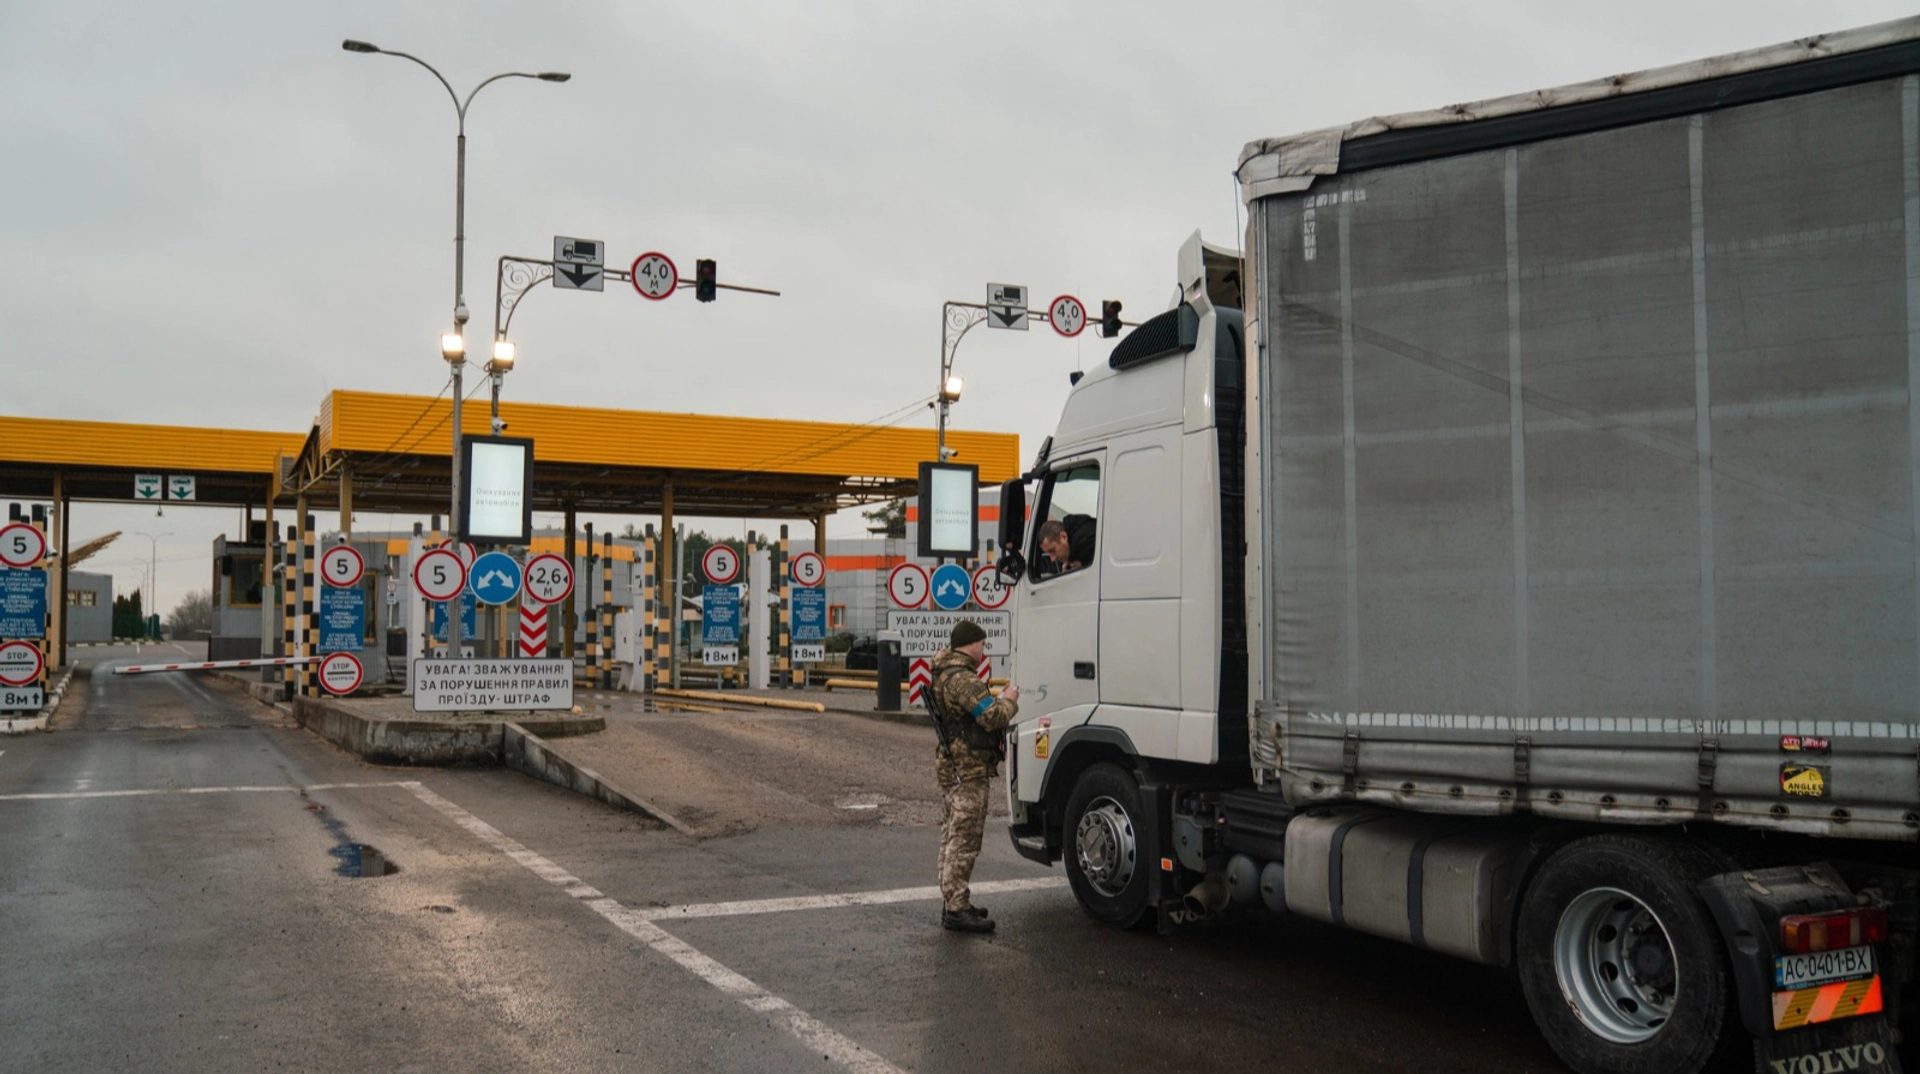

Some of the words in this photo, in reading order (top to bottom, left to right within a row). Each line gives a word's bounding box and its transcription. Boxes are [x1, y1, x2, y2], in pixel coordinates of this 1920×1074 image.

[13, 536, 27, 555] 5
[336, 558, 348, 575] 5
[717, 557, 727, 572] 5
[805, 563, 814, 577] 5
[433, 565, 447, 585] 5
[536, 567, 561, 586] 2,6
[904, 577, 914, 595] 5
[896, 616, 930, 625] УВАГА!
[907, 629, 951, 638] ПОРУШЕ
[7, 651, 28, 660] STOP
[332, 662, 350, 670] STOP
[425, 664, 471, 675] УВАГА!
[474, 664, 564, 675] ЗВАЖУВАННЯ!
[420, 680, 437, 691] ЗА
[440, 679, 518, 690] ПОРУШЕННЯ
[520, 679, 569, 689] ПРАВИЛ
[503, 693, 551, 704] ШТРАФ
[1788, 783, 1823, 791] ANGLES
[1770, 1041, 1885, 1074] VOLVO
